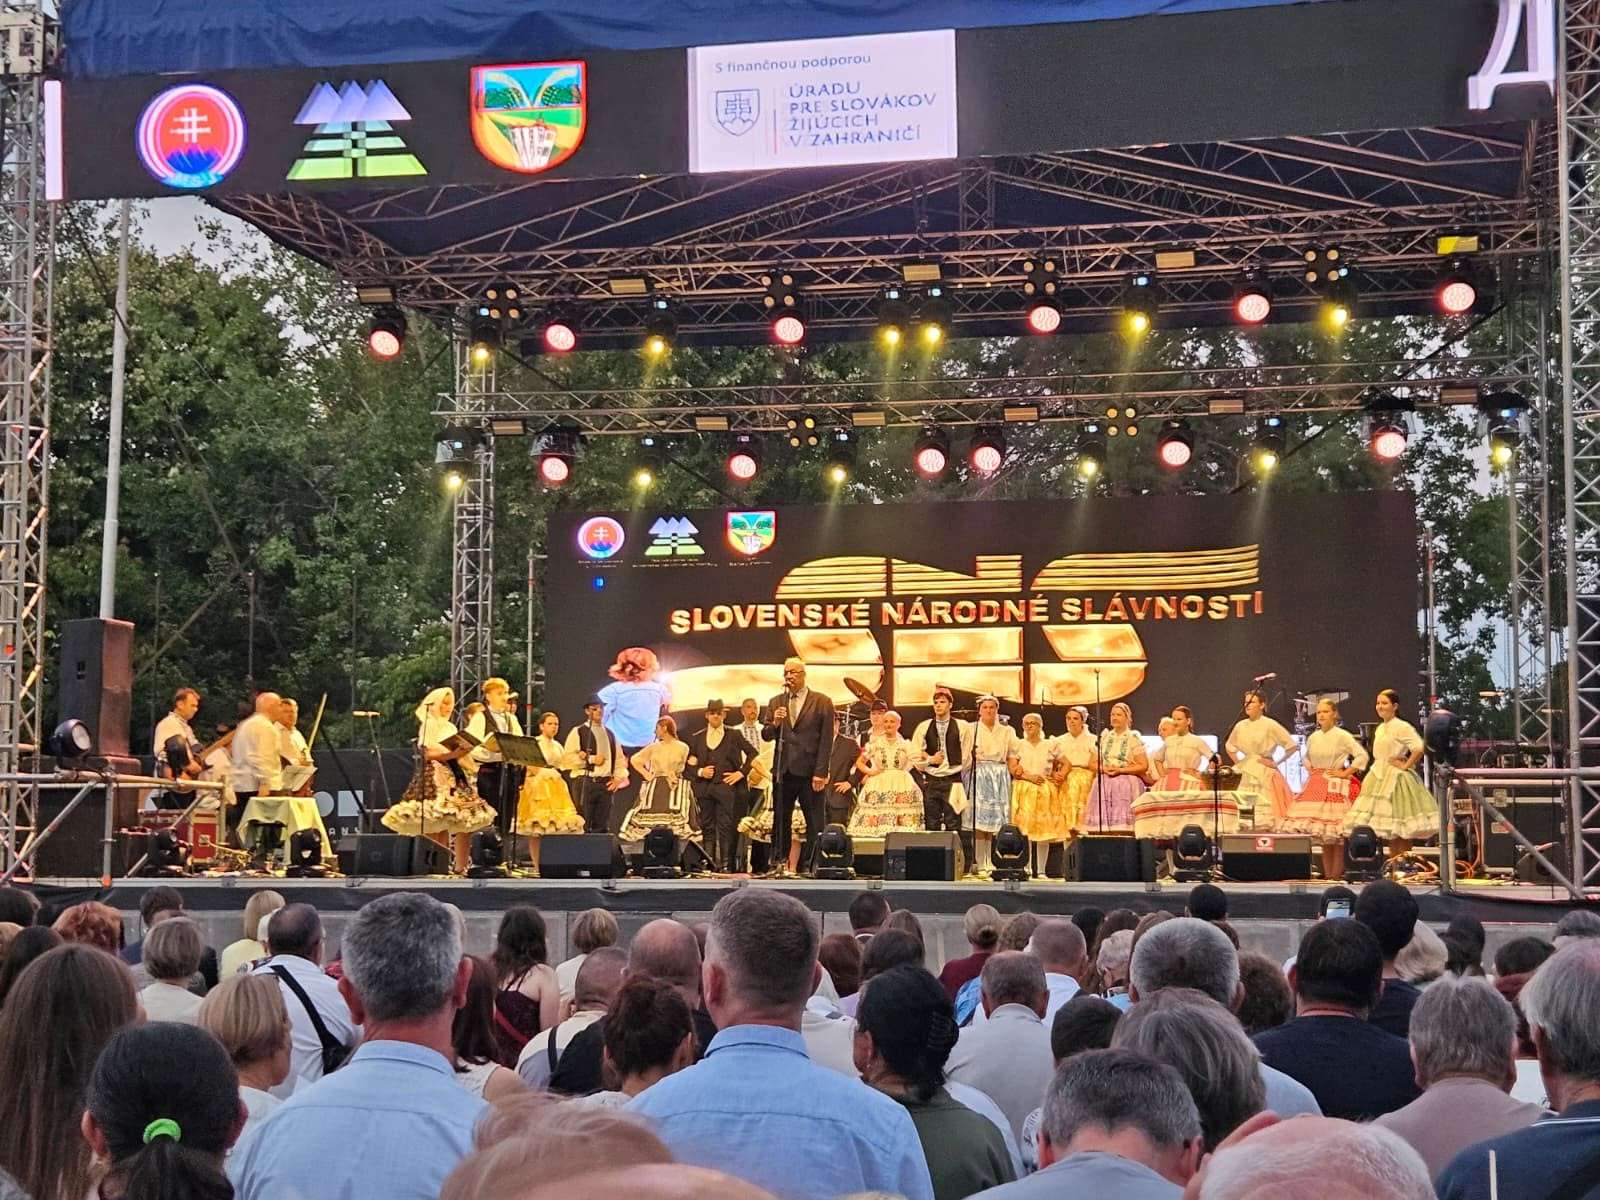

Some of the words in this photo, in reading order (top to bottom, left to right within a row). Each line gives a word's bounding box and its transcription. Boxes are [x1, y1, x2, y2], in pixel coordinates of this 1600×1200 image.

[715, 62, 723, 73] S
[727, 59, 797, 73] finančnou
[801, 55, 871, 69] podporou
[789, 81, 861, 99] ÚRADU
[789, 100, 822, 115] PRE
[831, 93, 937, 113] SLOVÁKOV
[789, 134, 802, 147] V
[811, 124, 921, 147] ZAHRANIČÍ
[670, 598, 871, 635] SLOVENSKÉ
[881, 593, 1050, 626] NÁRODNÉ
[1060, 590, 1264, 622] SLÁVNOSTI
